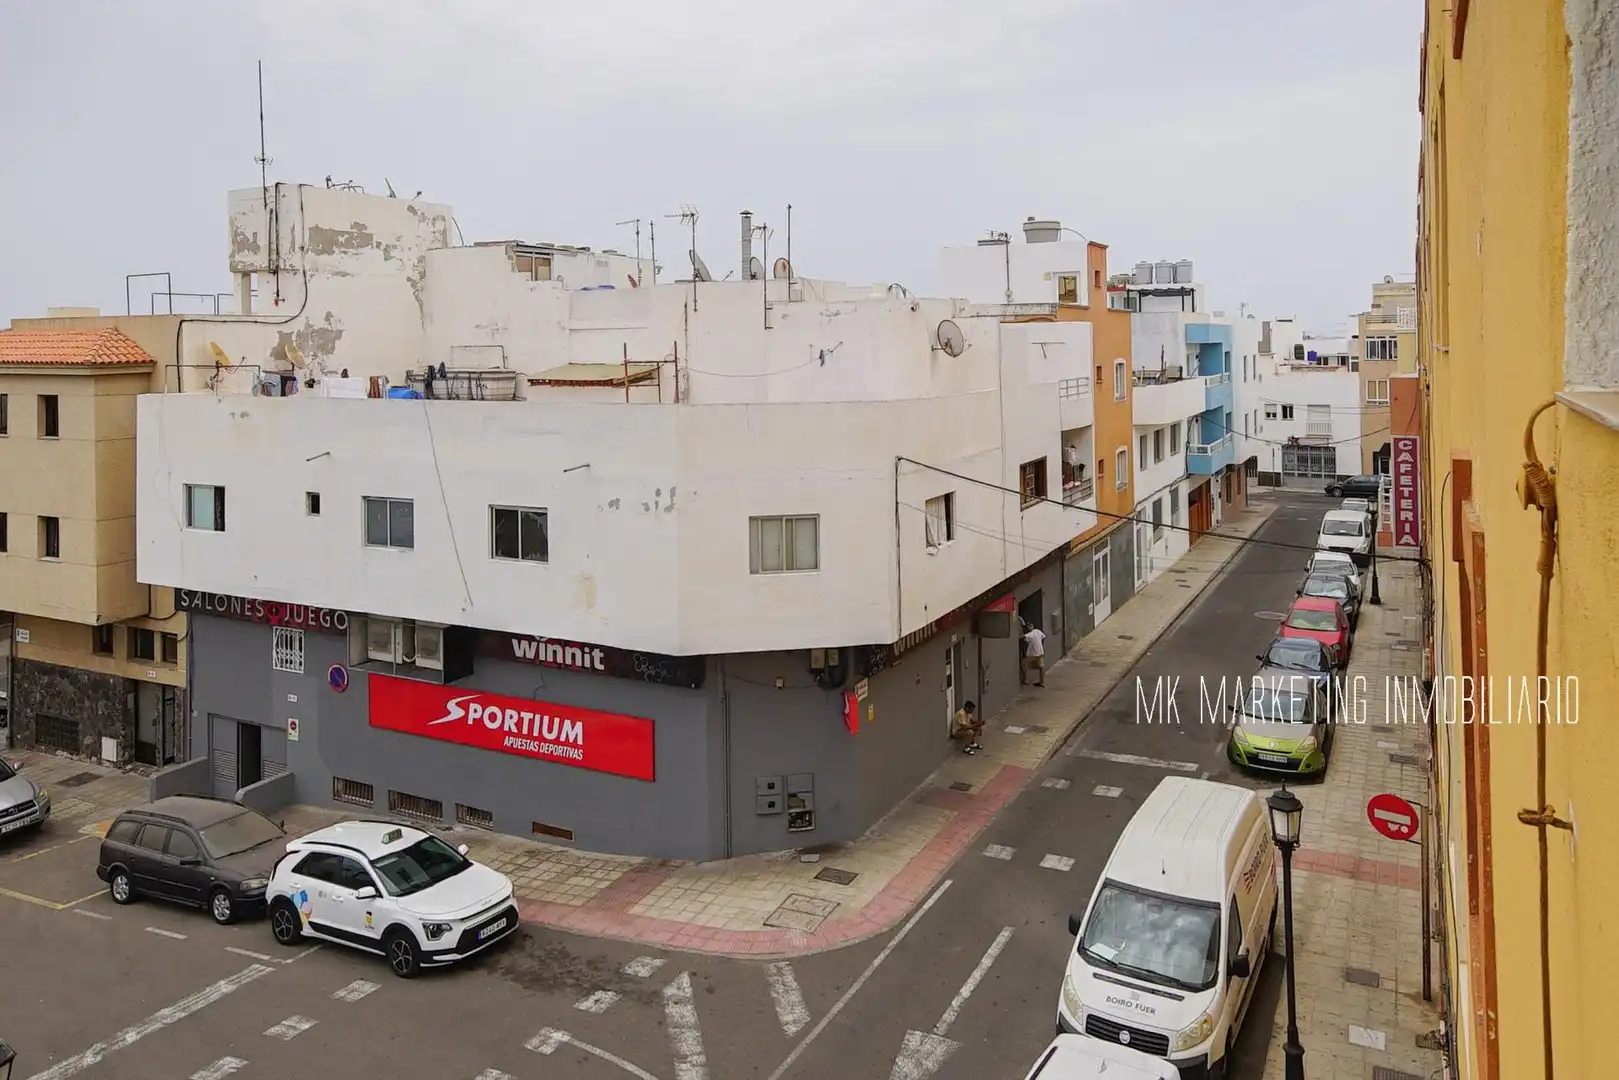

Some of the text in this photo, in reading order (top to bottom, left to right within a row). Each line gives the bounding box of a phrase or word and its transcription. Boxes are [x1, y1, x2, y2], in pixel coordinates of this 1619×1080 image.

[1396, 440, 1417, 545] CAFETERIA
[180, 588, 348, 630] SALONES JUEGO
[511, 636, 605, 671] winnit
[427, 694, 584, 745] SPORTIUM
[503, 736, 584, 761] APUESTAS DEPORTIVAS
[1106, 995, 1156, 1015] BOIRO FUER
